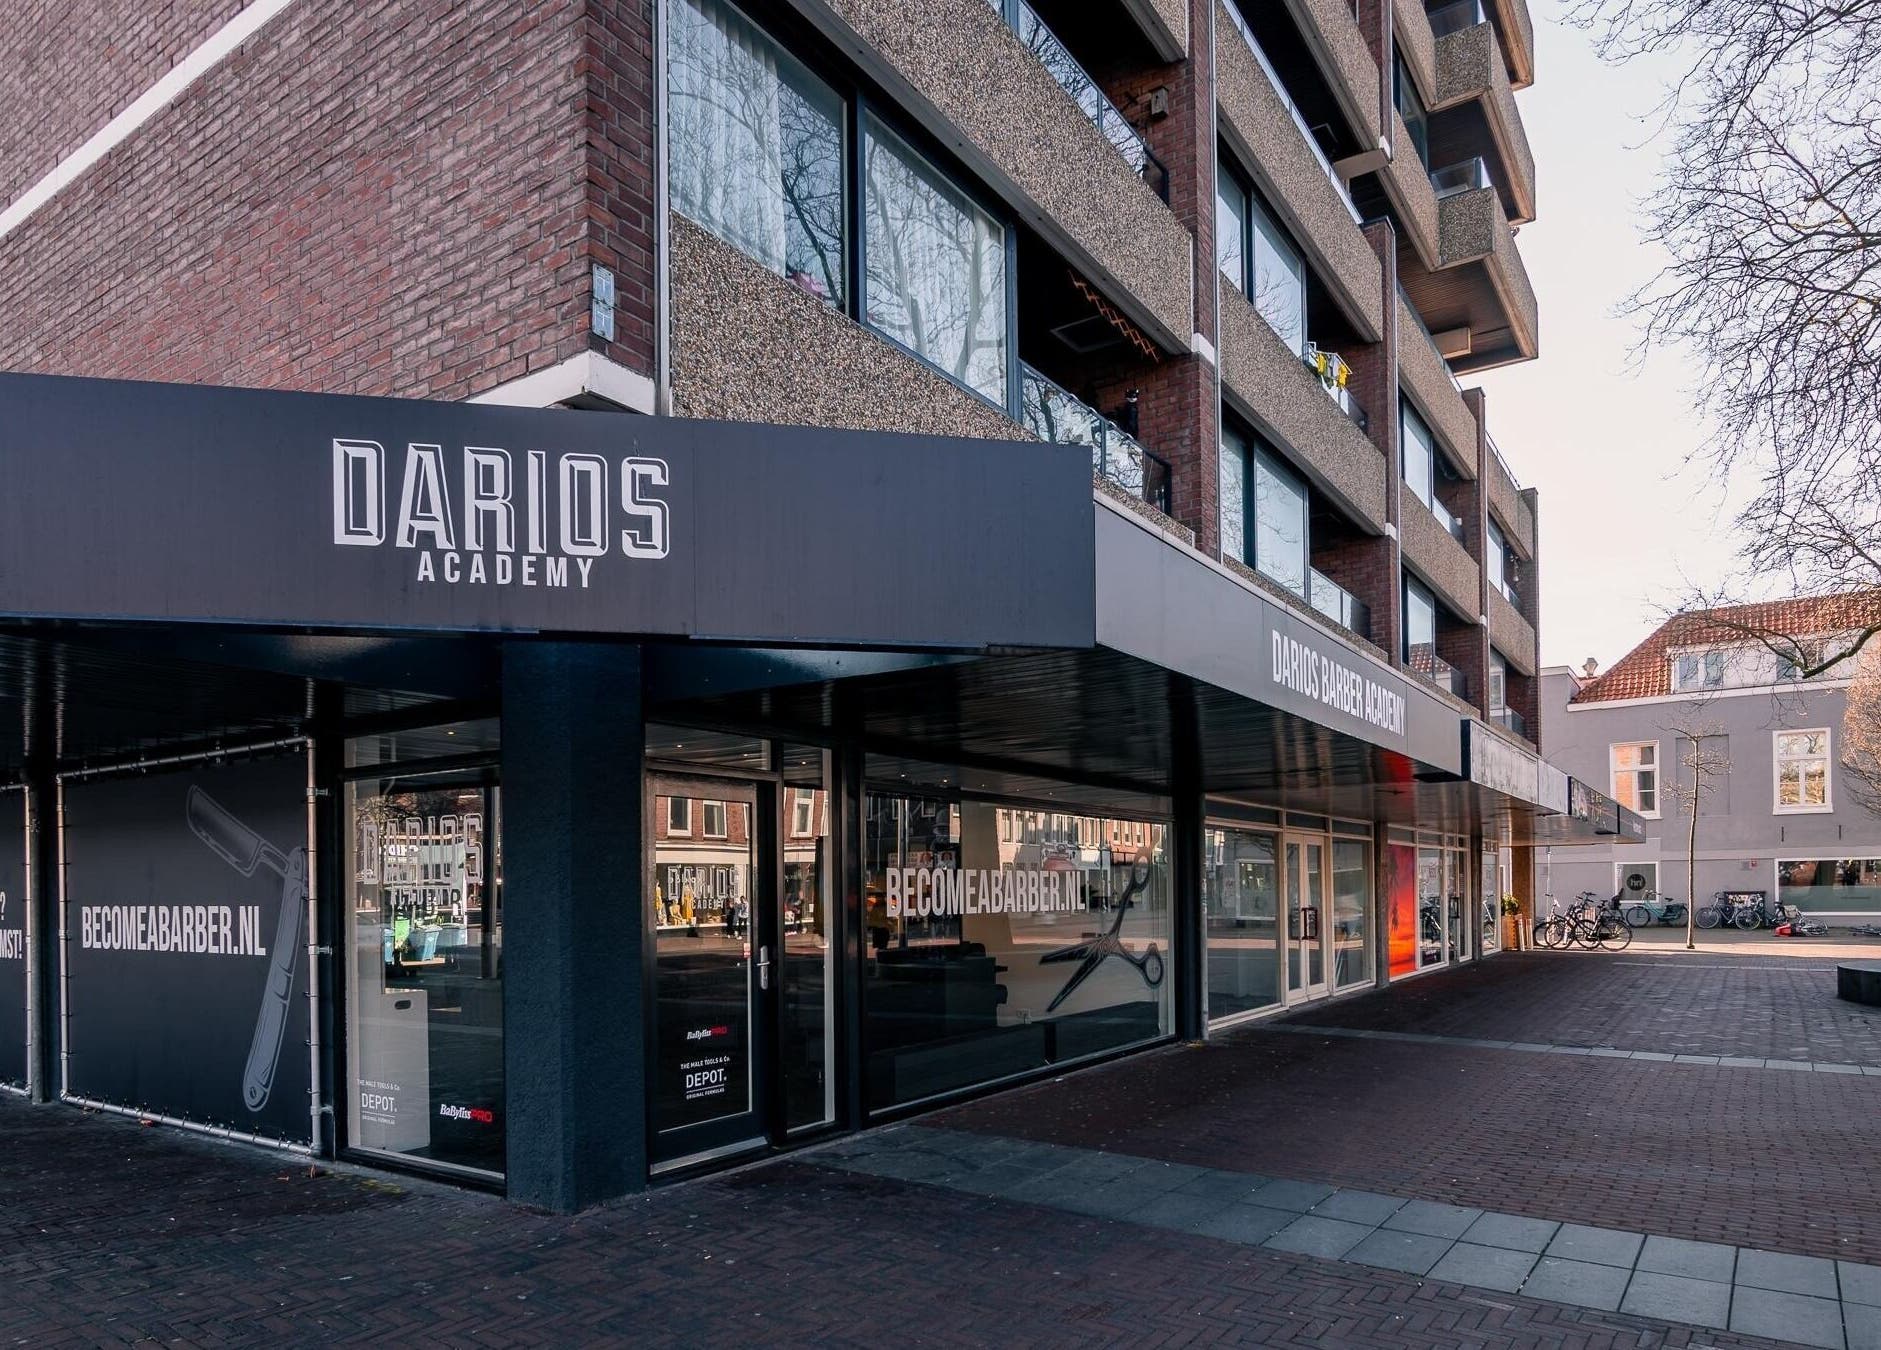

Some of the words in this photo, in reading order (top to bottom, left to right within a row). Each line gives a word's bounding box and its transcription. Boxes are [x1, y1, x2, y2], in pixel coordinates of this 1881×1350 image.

[333, 438, 670, 560] DARIOS
[417, 551, 593, 588] ACADEMY
[1272, 629, 1319, 700] DARIOS
[1321, 655, 1364, 719] BARBER
[1365, 679, 1405, 737] ACADEMY
[886, 867, 1086, 918] BECOMEABARBER.NL
[81, 905, 267, 956] BECOMEABARBER.NL
[680, 1062, 690, 1070] THE
[690, 1060, 704, 1068] MALE
[704, 1056, 719, 1066] TOOLS
[685, 1068, 728, 1089] DEPOT.
[361, 1092, 398, 1113] DEPOT.
